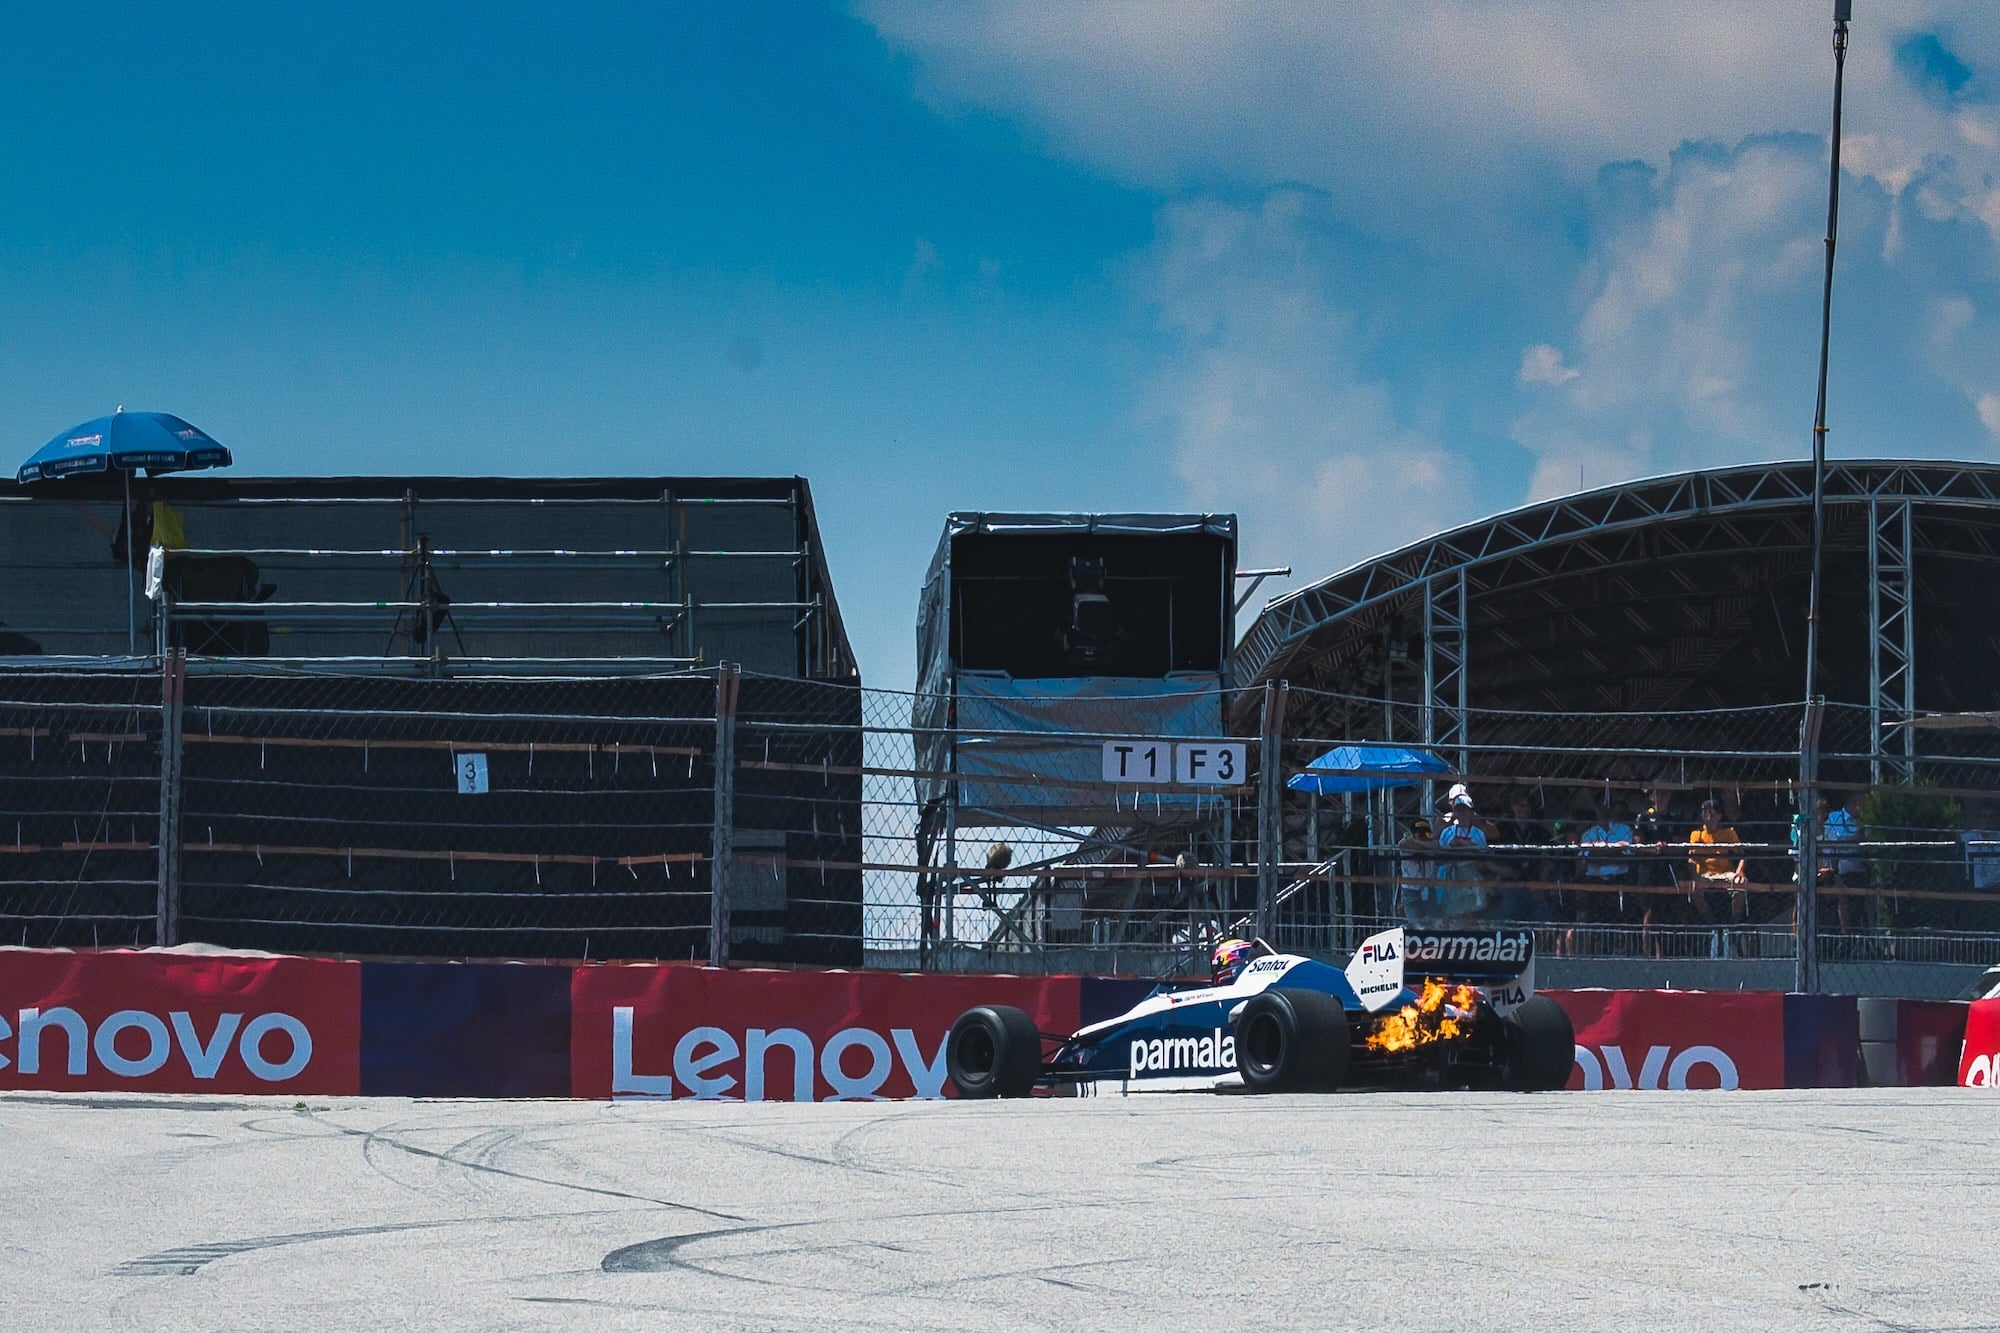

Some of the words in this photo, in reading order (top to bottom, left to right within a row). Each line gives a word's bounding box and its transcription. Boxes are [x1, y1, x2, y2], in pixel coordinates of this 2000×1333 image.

[465, 762, 476, 780] 3
[1363, 942, 1397, 965] FILA
[1404, 931, 1529, 962] parmalat
[1248, 959, 1289, 973] Santal
[1360, 982, 1399, 996] MICHELIN
[1490, 986, 1526, 1008] FILA
[0, 1006, 312, 1082] novo
